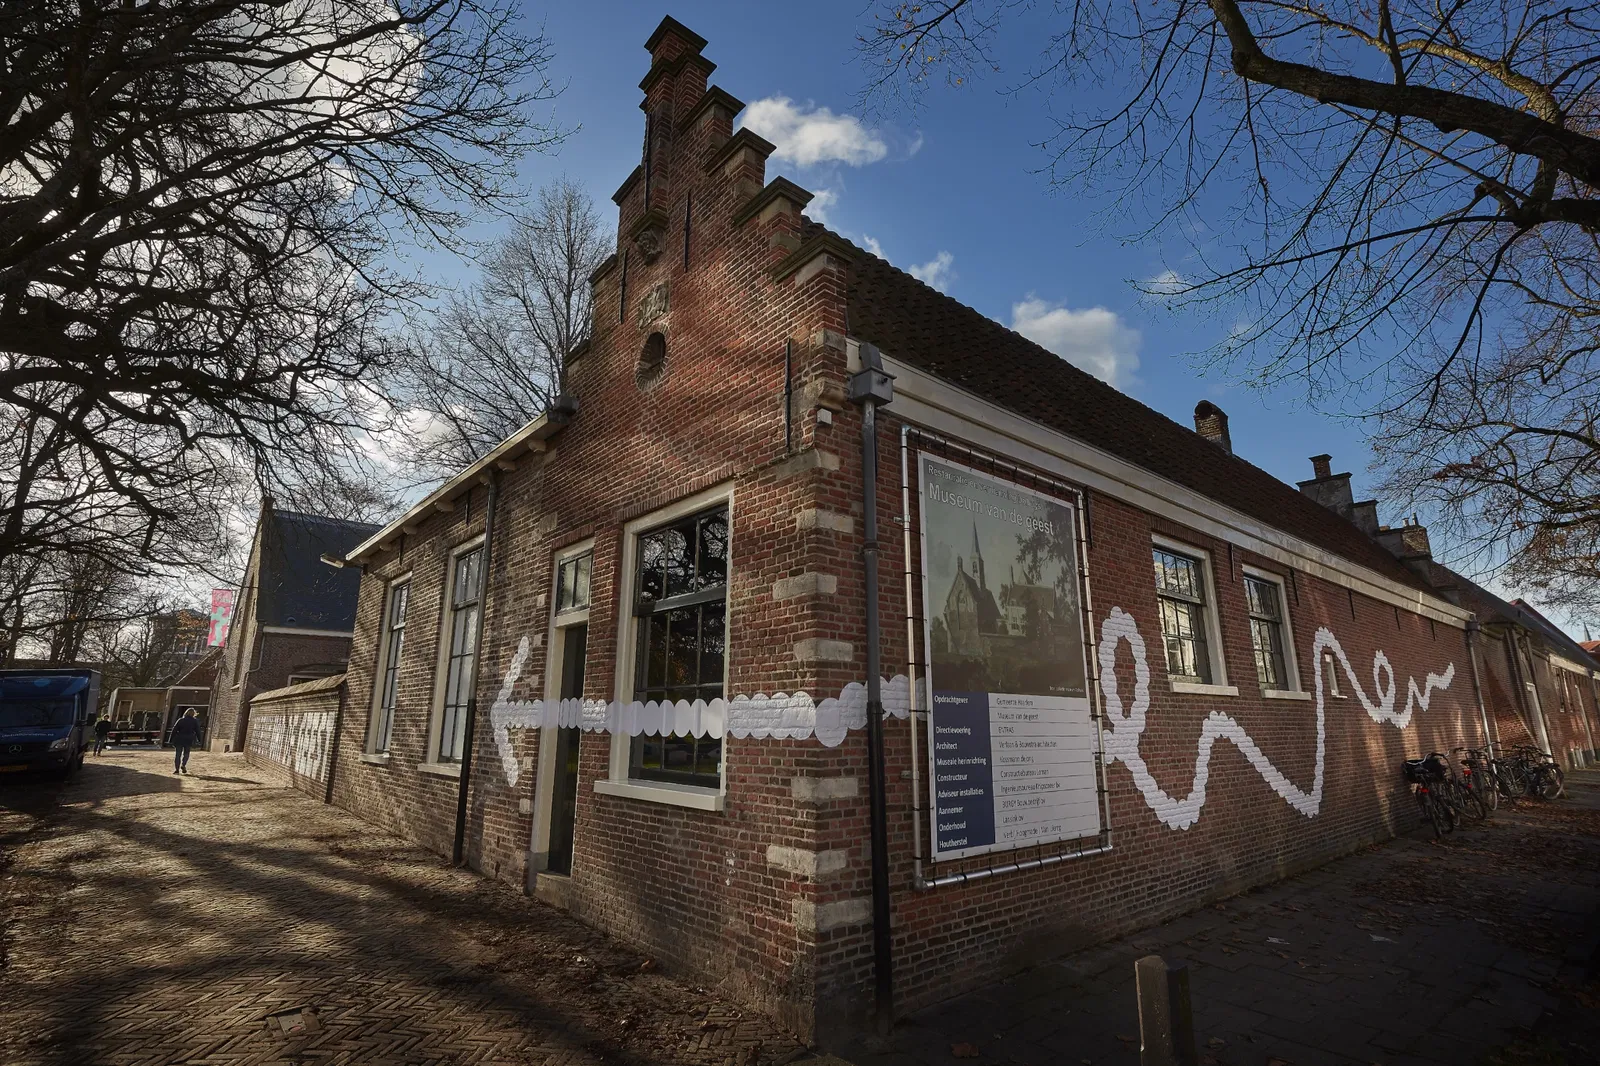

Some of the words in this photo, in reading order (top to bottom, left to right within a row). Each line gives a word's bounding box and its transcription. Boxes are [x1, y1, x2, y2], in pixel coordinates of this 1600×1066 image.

[929, 482, 983, 514] Museum
[985, 504, 1006, 521] van
[1010, 508, 1023, 526] de
[1025, 515, 1054, 536] geest
[934, 695, 968, 704] Opdrachtgever
[936, 726, 971, 735] Directievoering
[936, 742, 958, 750] Architect
[937, 757, 957, 766] Museale
[958, 756, 987, 766] herinrichting
[937, 773, 968, 782] Constructeur
[938, 789, 959, 799] Adviseur
[959, 788, 984, 797] installaties
[938, 805, 964, 815] Aannemer
[939, 820, 967, 832] Onderhoud
[939, 837, 968, 849] Houtherstel
